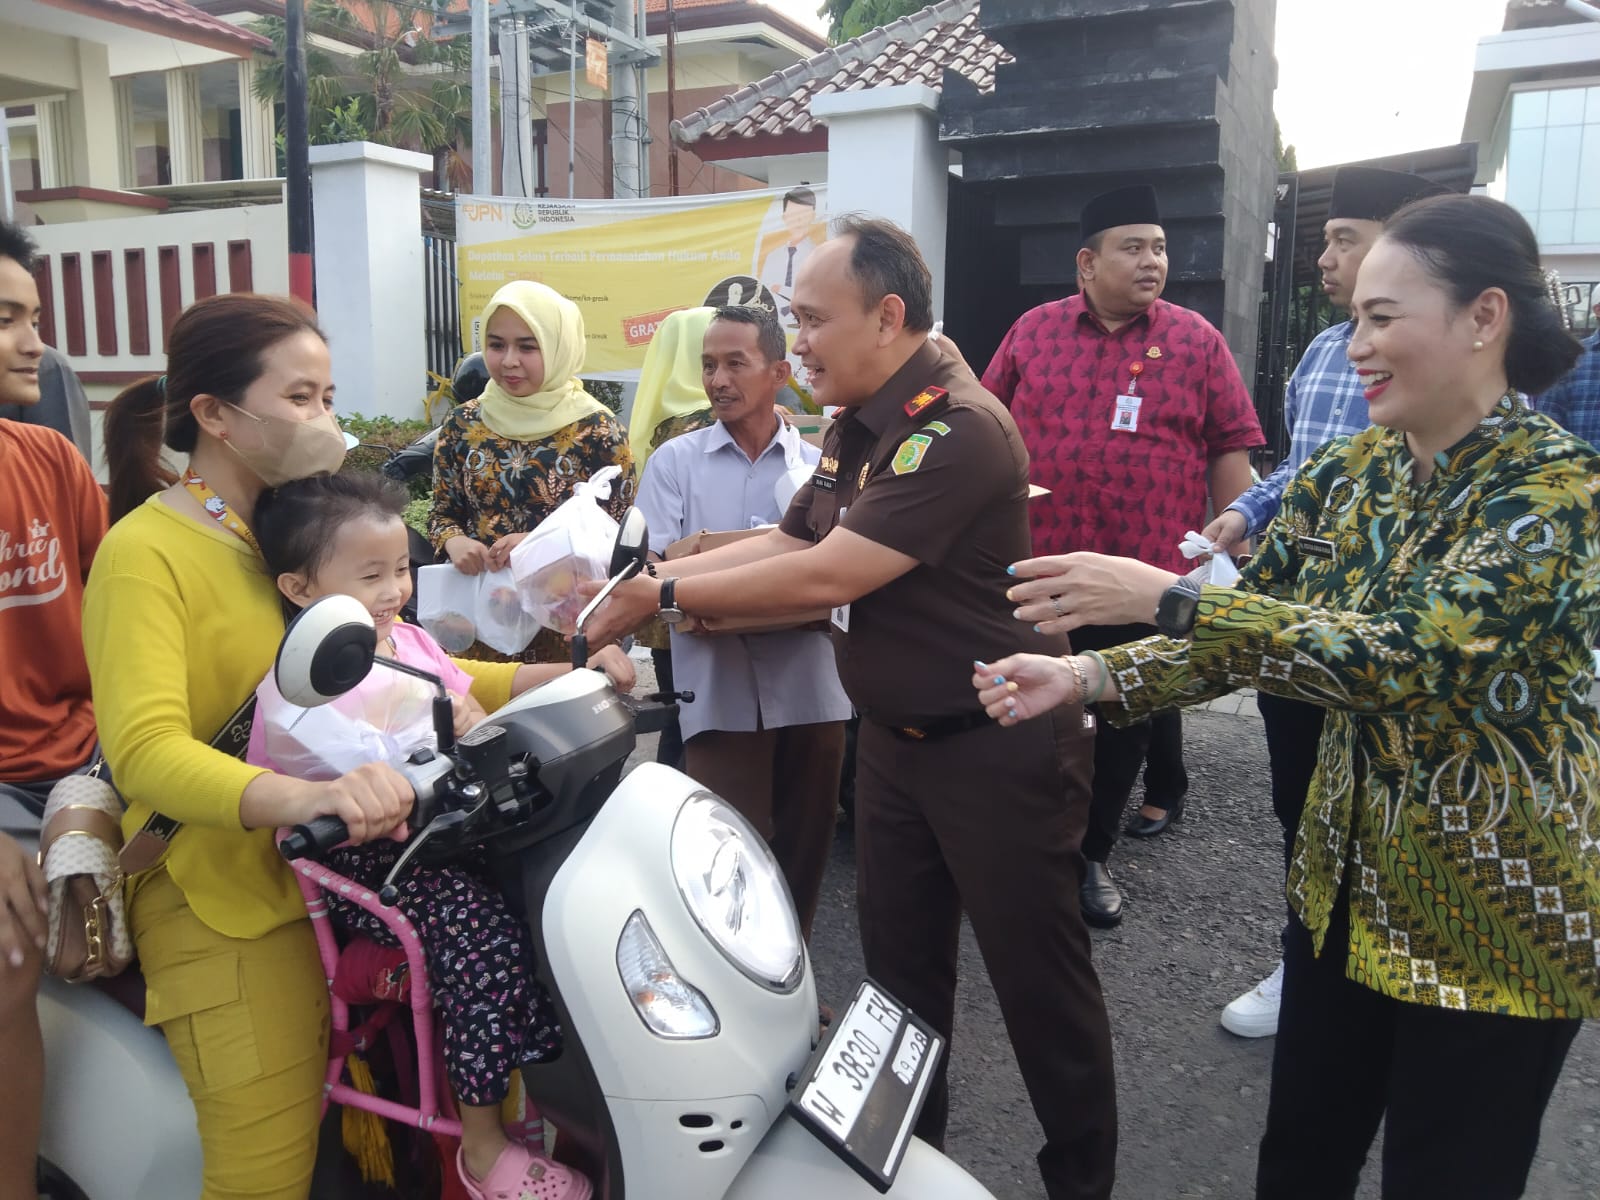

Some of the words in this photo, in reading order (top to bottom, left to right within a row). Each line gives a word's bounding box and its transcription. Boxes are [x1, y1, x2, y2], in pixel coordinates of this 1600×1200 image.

[538, 215, 576, 223] INDONESIA
[667, 249, 708, 262] Hukum
[711, 248, 740, 261] Anda
[812, 1090, 845, 1125] W
[832, 1028, 881, 1091] 3830
[865, 992, 901, 1033] FK
